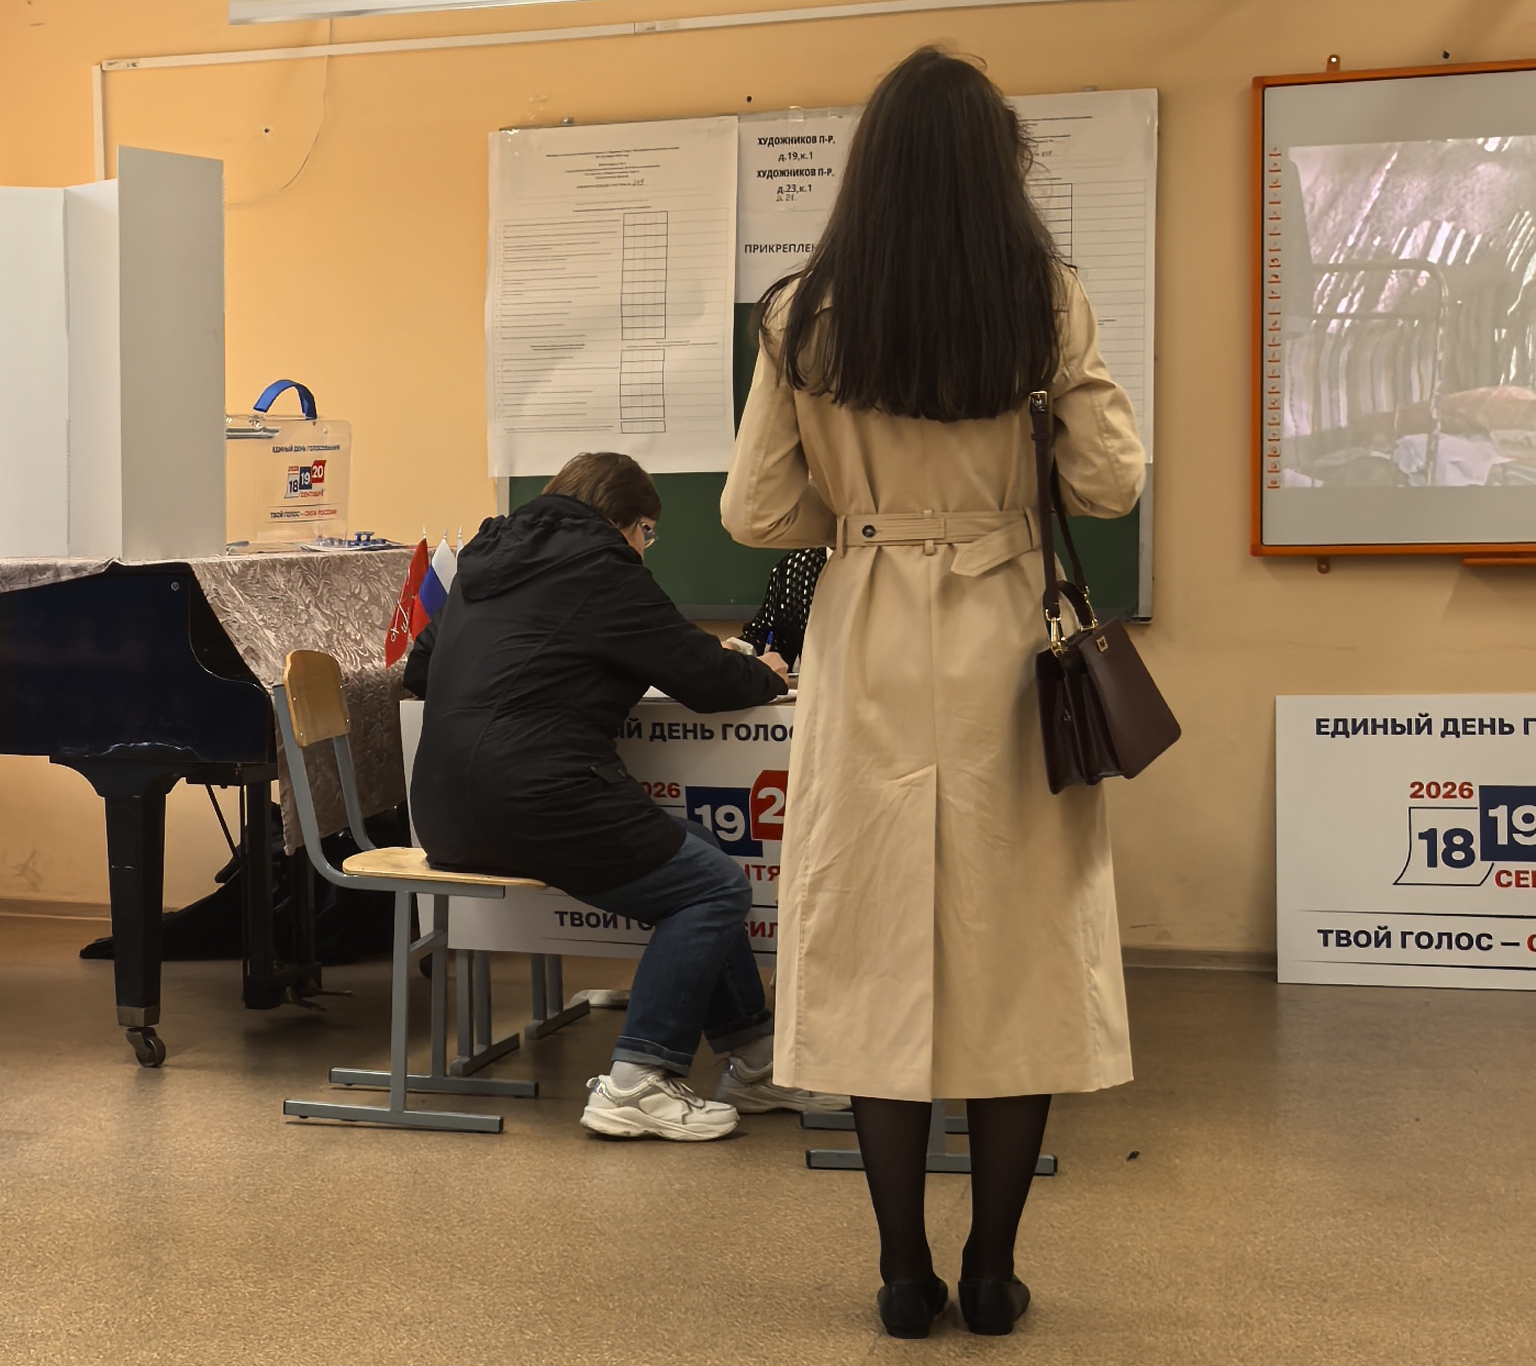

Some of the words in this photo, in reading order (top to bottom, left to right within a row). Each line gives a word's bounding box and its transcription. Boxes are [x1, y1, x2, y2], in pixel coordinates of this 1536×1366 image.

[757, 136, 817, 147] ХУДОЖНИКОВ
[756, 168, 816, 180] ХУДОЖНИКОВ
[744, 243, 814, 254] ПРИКРЕПЛЕ
[300, 472, 311, 485] 19
[312, 465, 324, 478] 20
[289, 480, 299, 493] 18
[649, 722, 715, 742] ДЕНЬ
[721, 723, 794, 742] ГОЛО
[1315, 713, 1433, 738] ЕДИНЫЙ
[1440, 717, 1515, 738] ДЕНЬ
[640, 781, 681, 799] 026
[1409, 781, 1474, 799] 2026
[757, 786, 785, 824] 2
[693, 803, 746, 843] 19
[1488, 804, 1536, 846] 19
[1417, 827, 1476, 869] 18
[1494, 869, 1536, 888] СЕ
[1317, 926, 1392, 949] ТВОЙ
[1400, 930, 1493, 951] ГОЛОС
